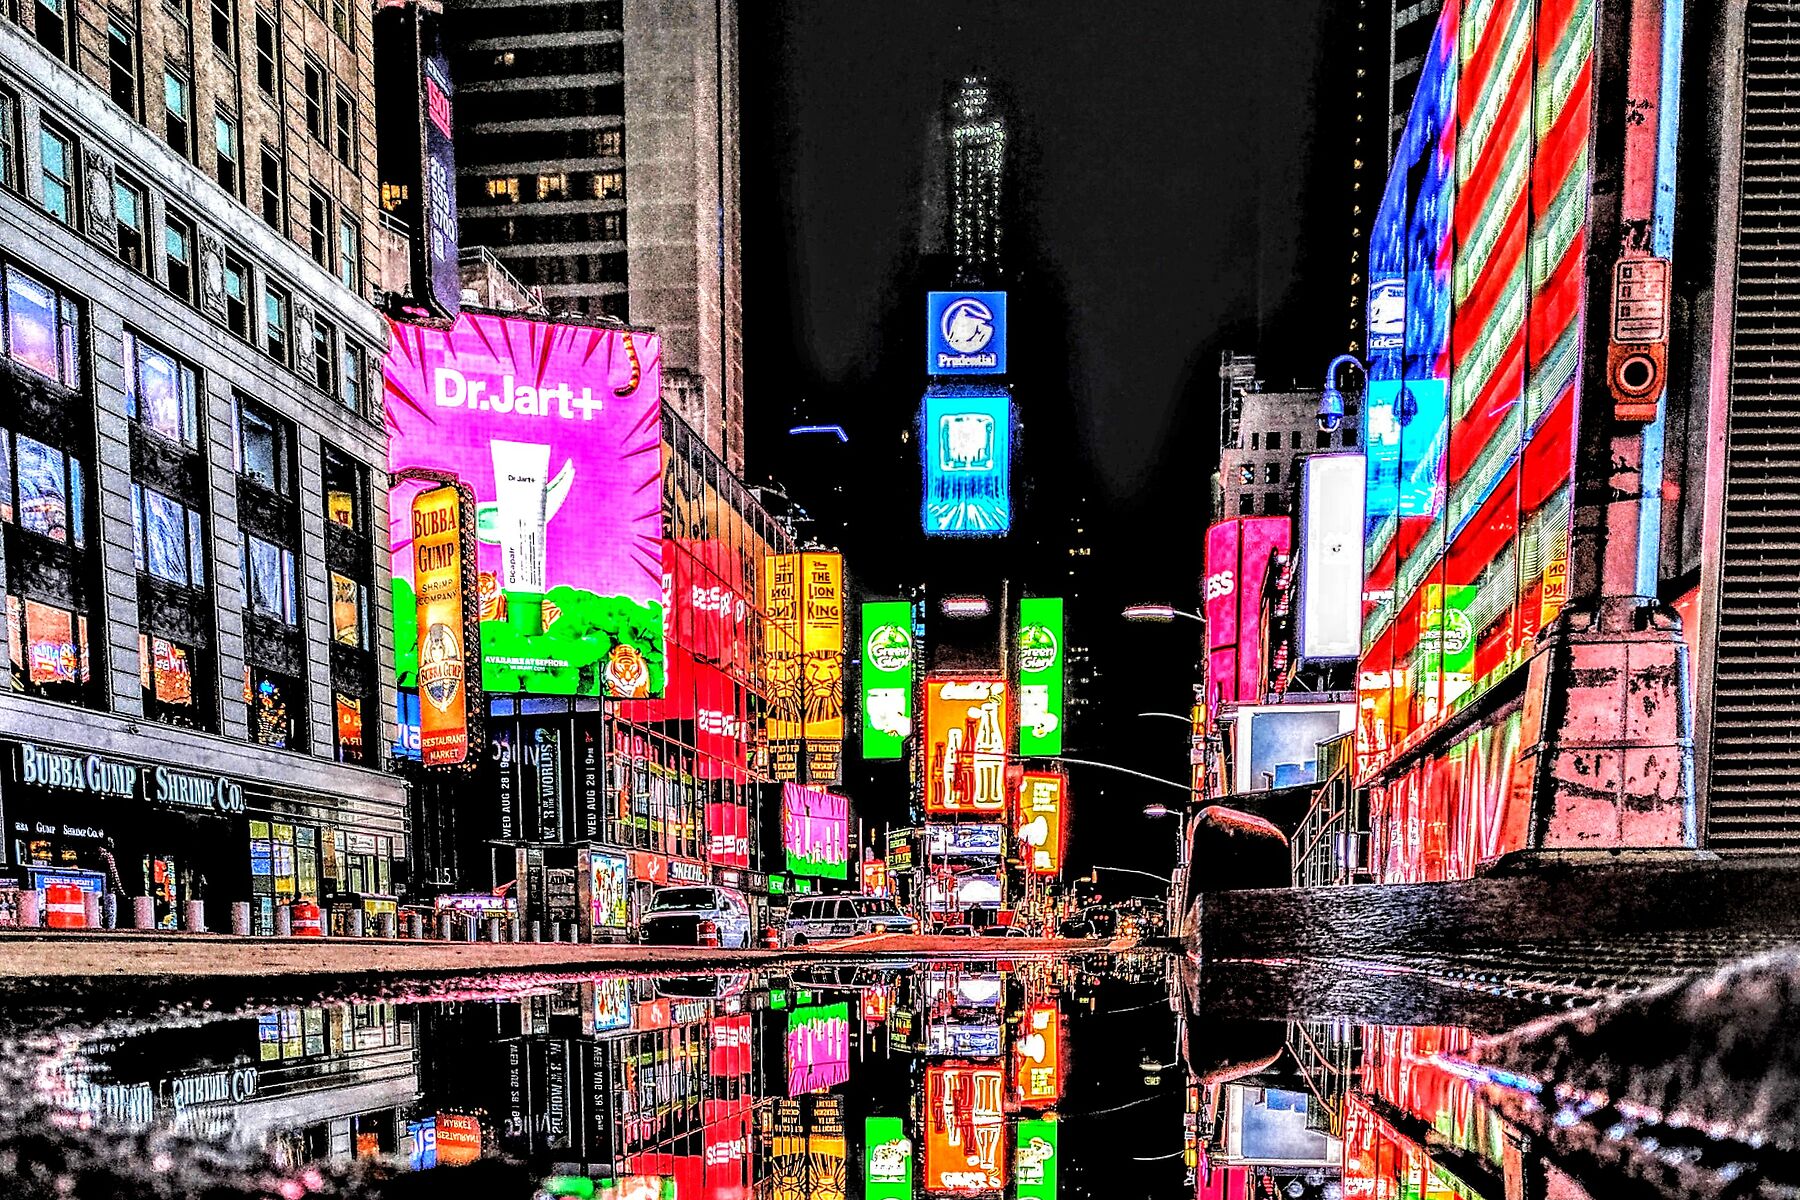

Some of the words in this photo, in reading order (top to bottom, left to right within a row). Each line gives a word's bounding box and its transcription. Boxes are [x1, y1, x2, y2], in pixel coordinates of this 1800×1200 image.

[430, 156, 447, 192] 212
[938, 352, 997, 368] Prudential
[434, 367, 603, 421] Dr.Jart+
[413, 505, 457, 540] BUBBA
[418, 542, 455, 573] GUMP
[508, 546, 516, 584] Cicapair
[421, 578, 454, 593] SHRIMP
[811, 571, 830, 582] THE
[417, 588, 460, 606] COMPANY
[808, 583, 835, 600] LION
[807, 600, 839, 620] KING
[873, 644, 910, 656] Green
[422, 734, 466, 748] RESTAURANT
[430, 749, 459, 760] MARKET
[22, 742, 86, 790] BUBBA
[86, 753, 137, 796] GUMP
[155, 765, 215, 809] SHRIMP
[501, 777, 510, 789] 28
[585, 773, 595, 786] 28
[501, 793, 511, 813] AUG
[586, 790, 596, 810] AUG
[503, 815, 512, 838] WED
[587, 812, 597, 836] WED
